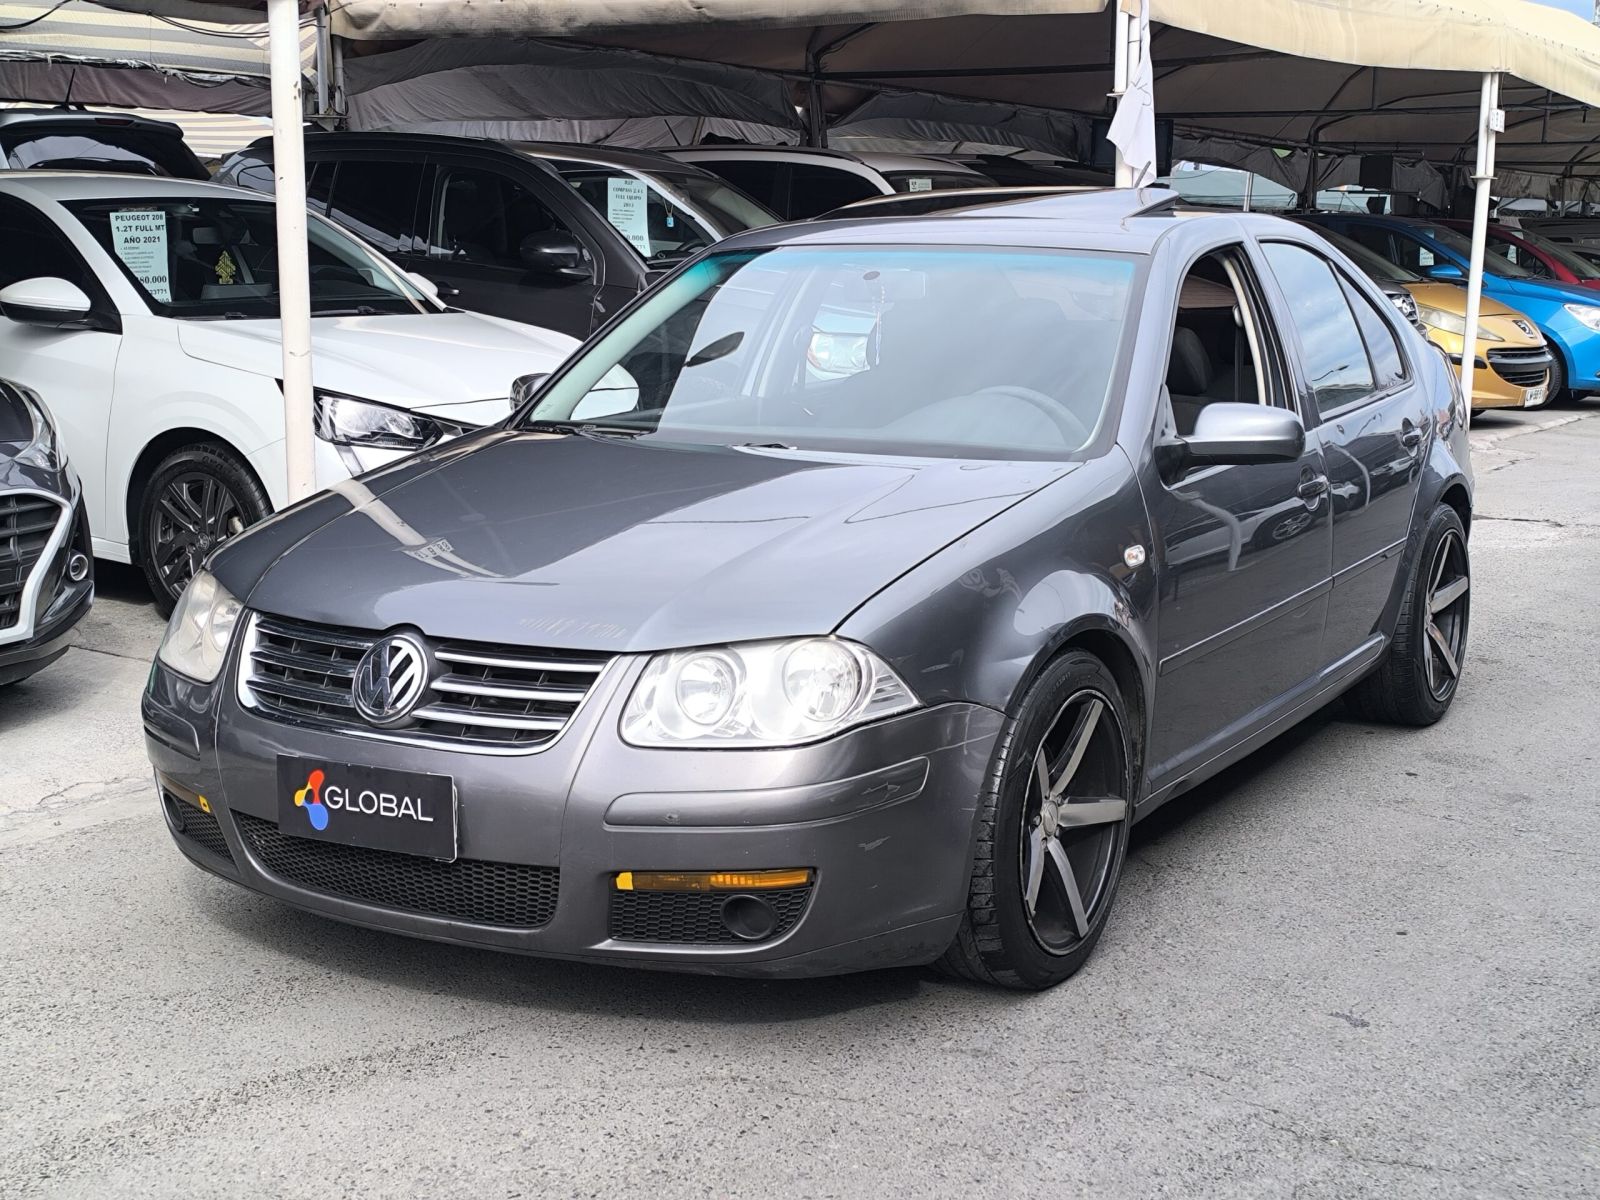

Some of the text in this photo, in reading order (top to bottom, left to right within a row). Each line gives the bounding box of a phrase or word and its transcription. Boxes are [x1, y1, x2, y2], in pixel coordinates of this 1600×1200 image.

[124, 235, 161, 244] AÑO 2021
[324, 785, 434, 822] GLOBAL
